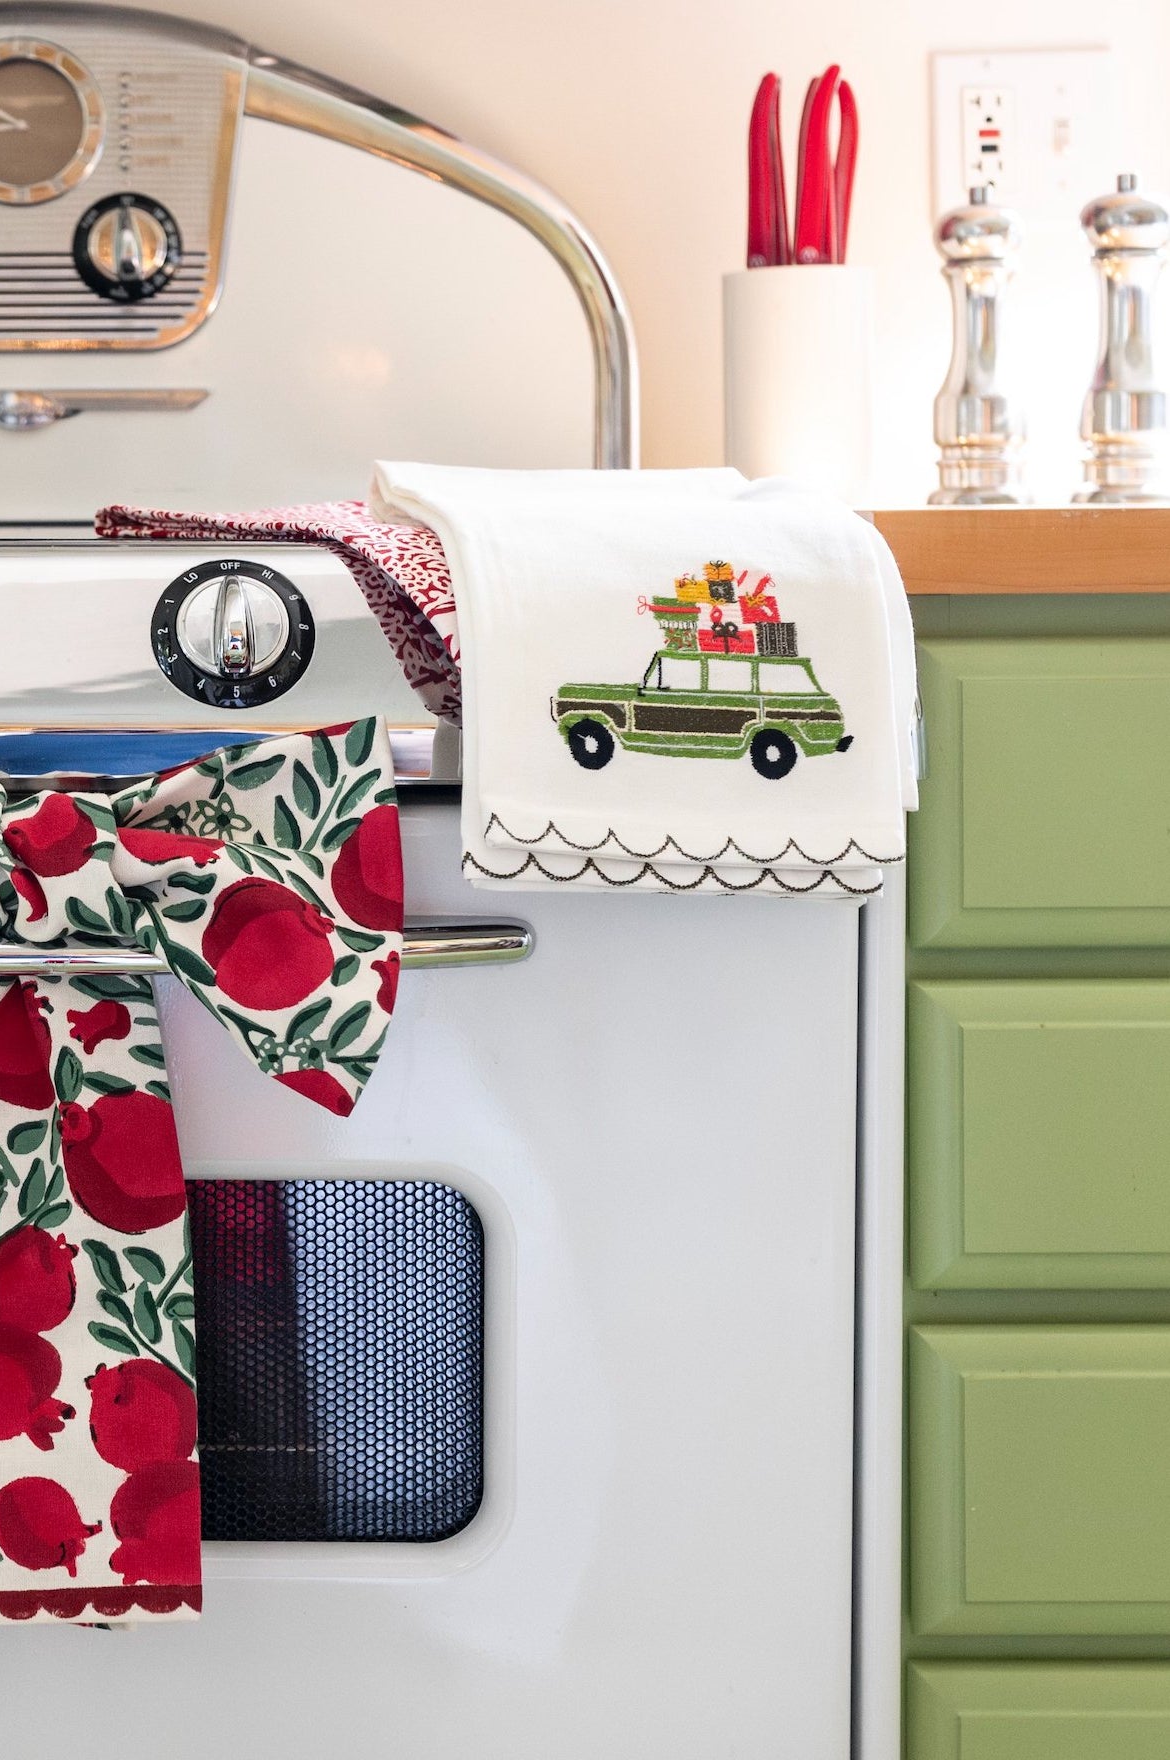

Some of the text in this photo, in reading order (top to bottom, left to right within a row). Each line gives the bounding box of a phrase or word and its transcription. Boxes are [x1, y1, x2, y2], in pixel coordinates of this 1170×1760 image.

[220, 562, 241, 570] OFF
[183, 572, 199, 584] LO
[261, 569, 274, 580] HI
[157, 627, 169, 635] 2
[299, 623, 310, 631] 8
[167, 653, 179, 663] 3
[291, 650, 302, 660] 7
[197, 678, 206, 690] 4
[268, 675, 277, 687] 6
[233, 686, 240, 698] 5
